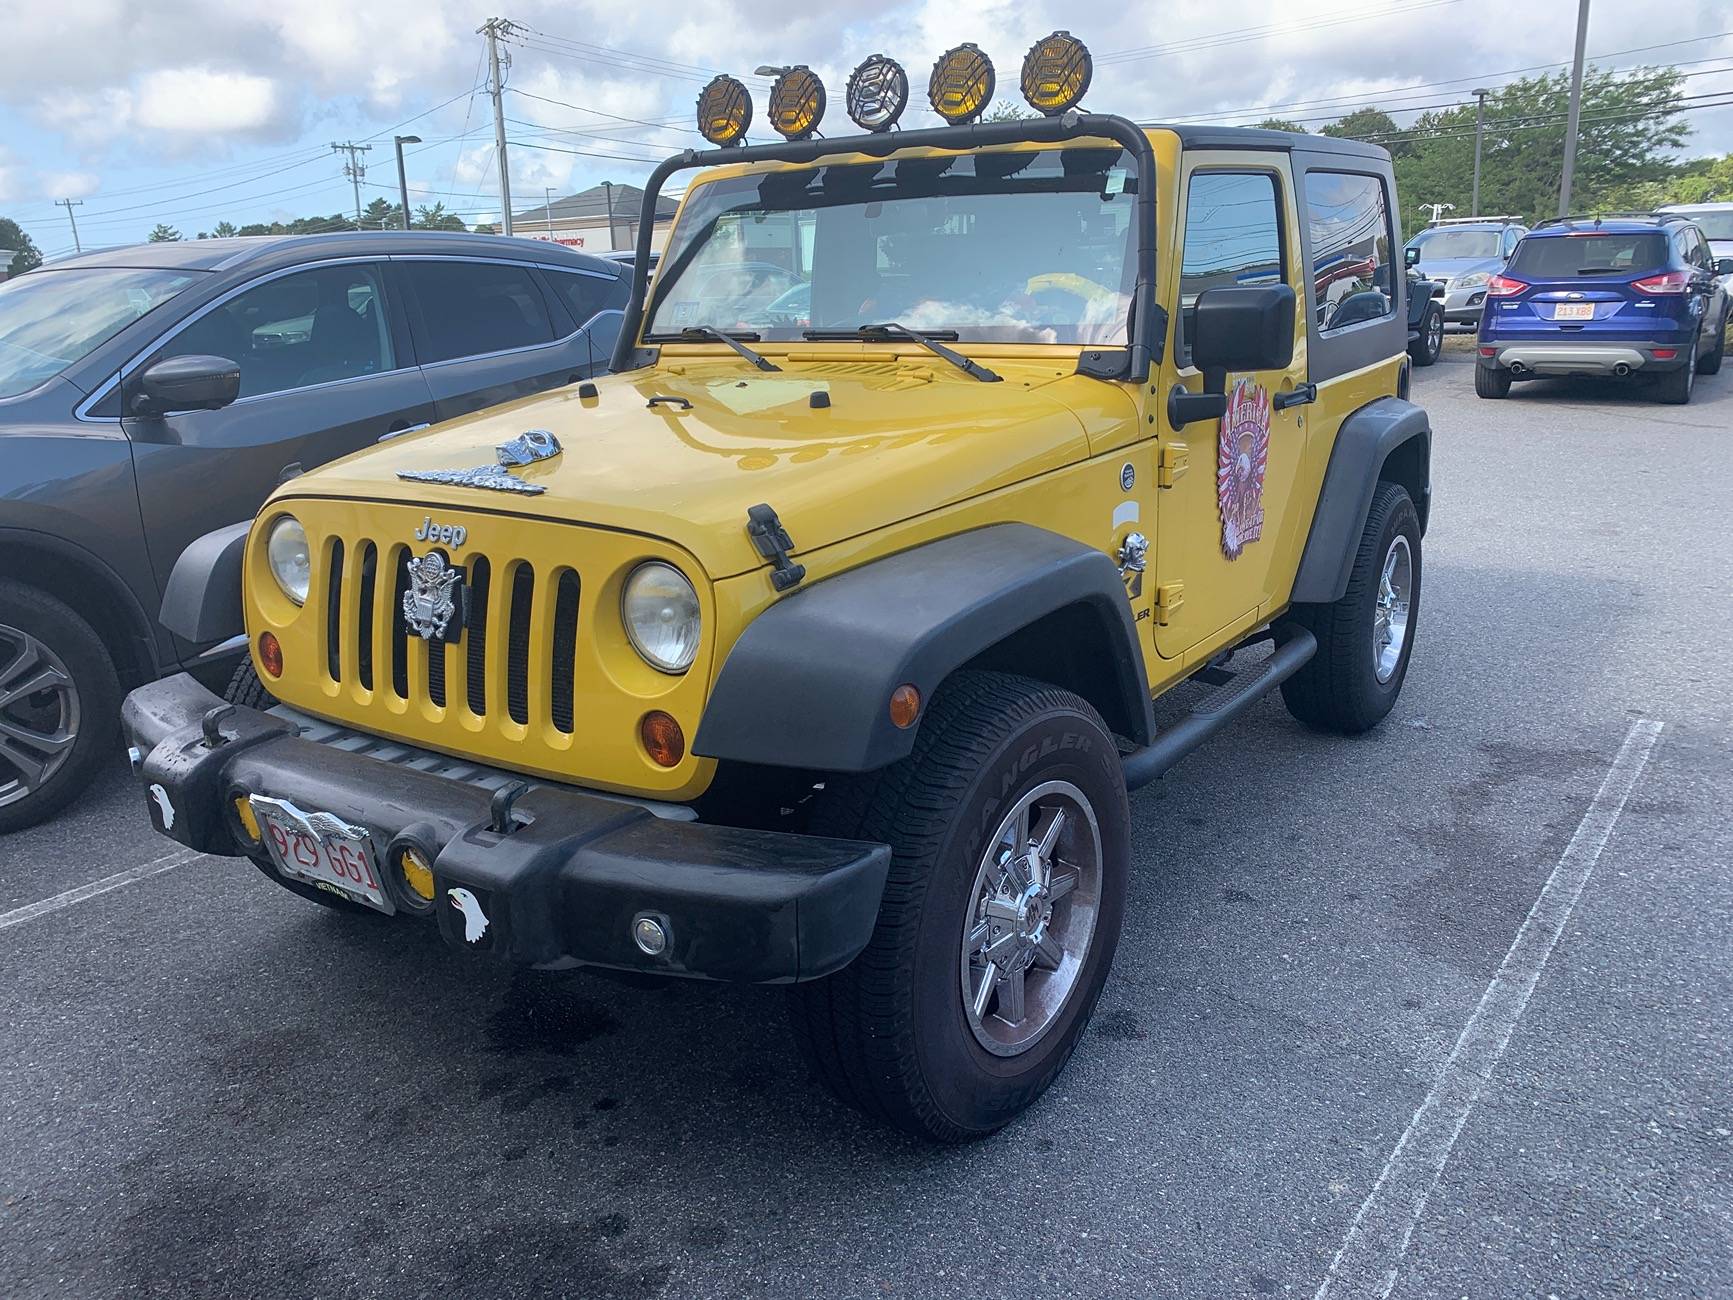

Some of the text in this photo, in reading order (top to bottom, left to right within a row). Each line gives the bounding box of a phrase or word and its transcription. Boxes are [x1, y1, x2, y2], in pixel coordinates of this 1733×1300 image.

[415, 516, 467, 550] Jeep
[269, 823, 379, 890] 929 GG1
